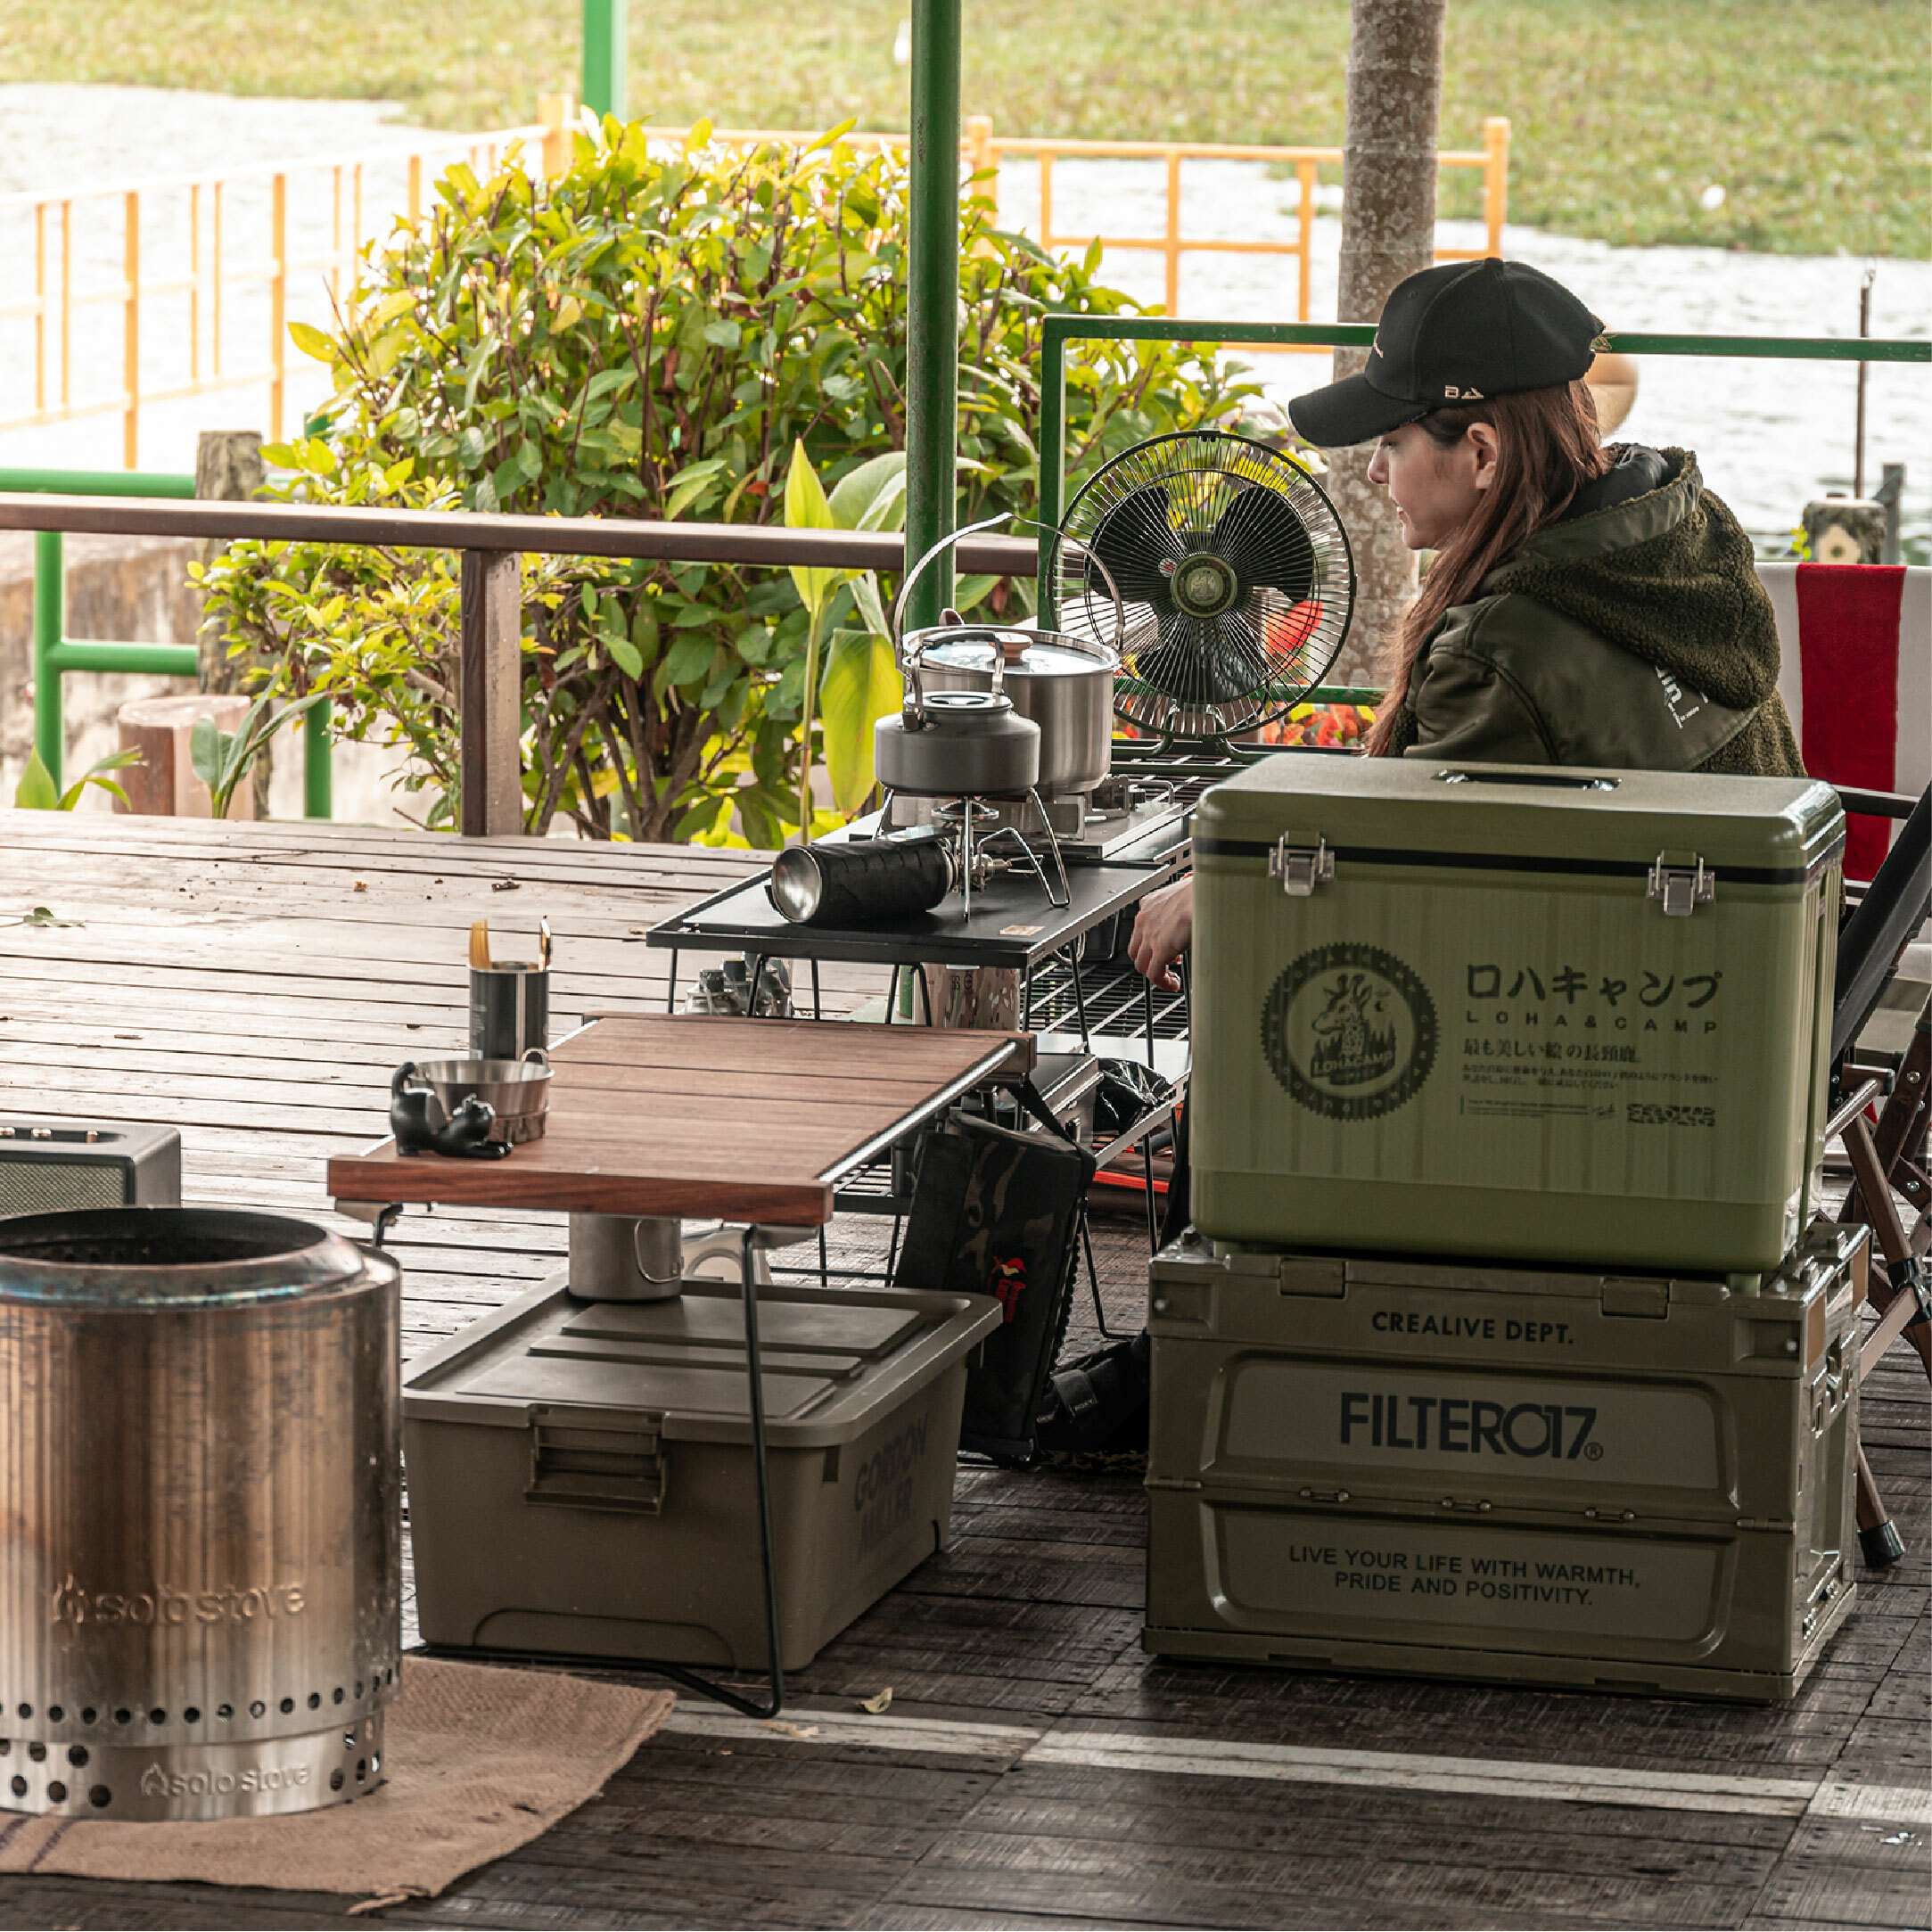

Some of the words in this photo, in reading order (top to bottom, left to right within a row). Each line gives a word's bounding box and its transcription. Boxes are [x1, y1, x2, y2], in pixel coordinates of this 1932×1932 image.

[1467, 964, 1722, 1008] ロハキャンプ
[1371, 1311, 1496, 1339] CREALIVE
[1506, 1319, 1574, 1344] DEPT.
[855, 1410, 928, 1512] GORDON
[1289, 1545, 1337, 1565] LIVE
[1344, 1549, 1408, 1569] YOUR
[1416, 1554, 1463, 1574] LIFE
[1471, 1558, 1527, 1577] WITH
[1534, 1562, 1640, 1589] WARMTH,
[1336, 1572, 1402, 1592] PRIDE
[1410, 1576, 1458, 1596] AND
[1465, 1580, 1593, 1606] POSITIVITY.
